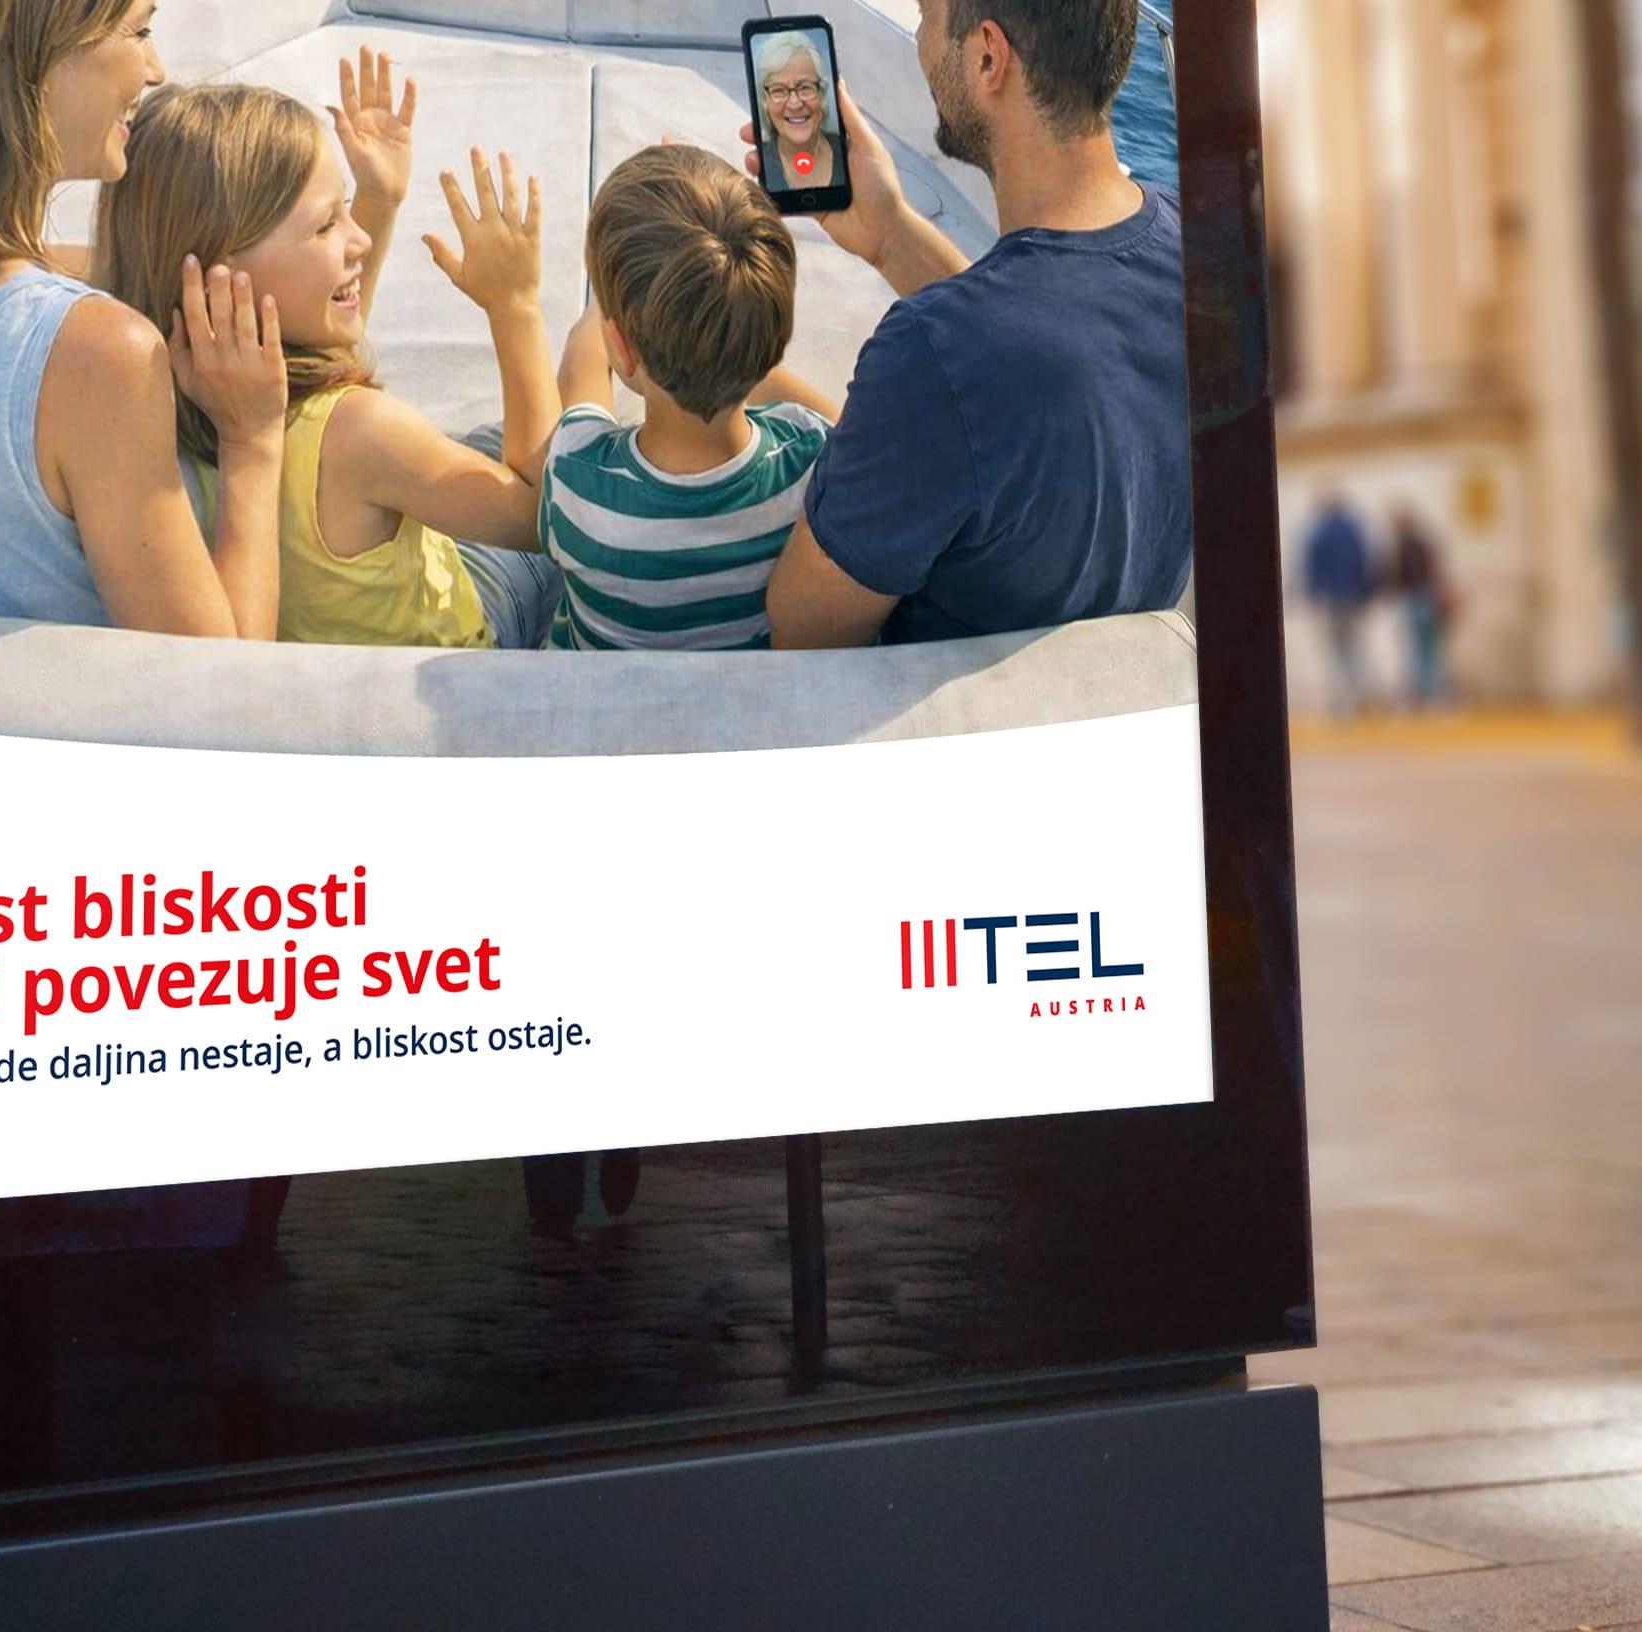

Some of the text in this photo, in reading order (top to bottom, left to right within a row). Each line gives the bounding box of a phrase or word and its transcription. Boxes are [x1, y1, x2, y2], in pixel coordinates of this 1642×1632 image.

[74, 865, 366, 939] bliskosti
[24, 955, 339, 1036] povezuje
[363, 938, 500, 997] svet
[1030, 996, 1145, 1018] AUSTRIA
[50, 1042, 166, 1086] daljina
[181, 1033, 311, 1074] nestaje,
[324, 1039, 340, 1062] a
[354, 1024, 478, 1059] bliskost
[488, 1016, 591, 1056] ostaje.
